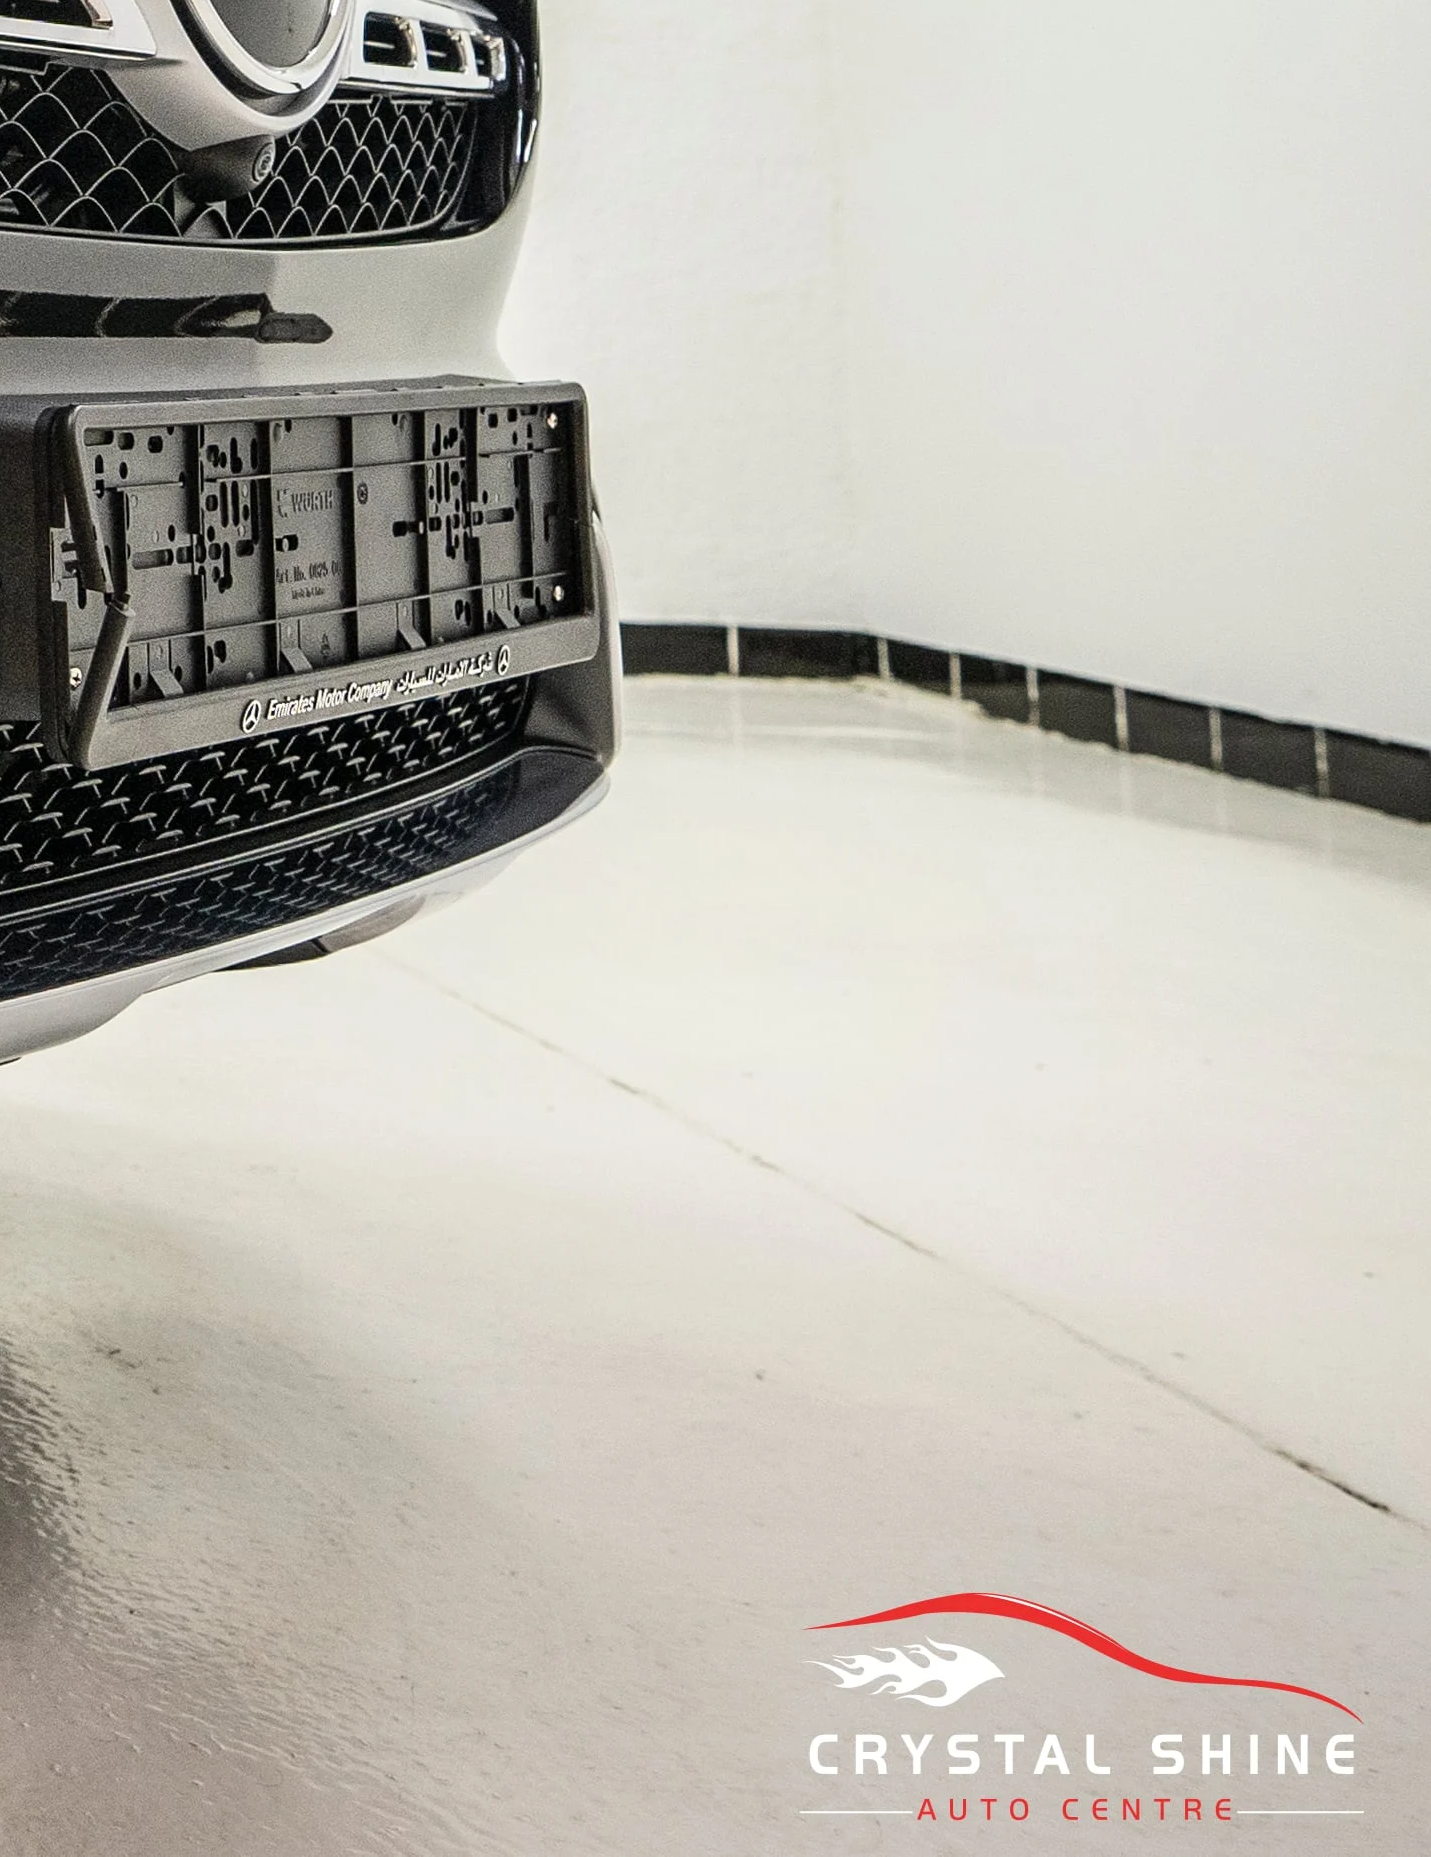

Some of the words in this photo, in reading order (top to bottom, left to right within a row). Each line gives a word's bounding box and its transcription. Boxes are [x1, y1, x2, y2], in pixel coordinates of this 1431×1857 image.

[266, 695, 316, 721] Emirates
[316, 688, 348, 710] Motor
[347, 679, 394, 704] Company
